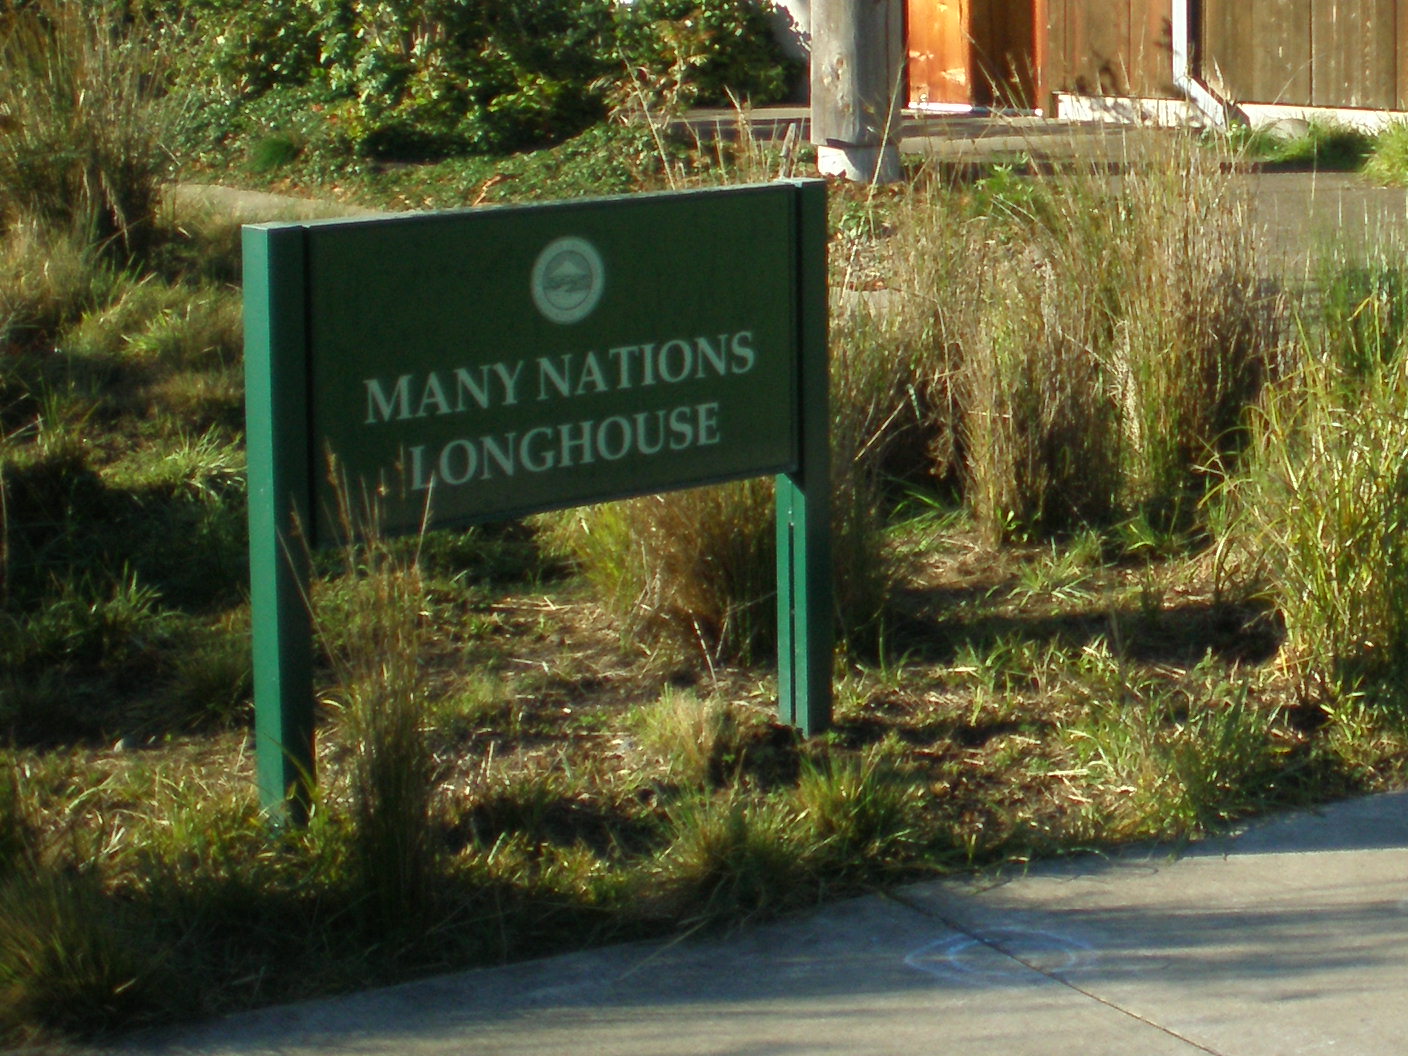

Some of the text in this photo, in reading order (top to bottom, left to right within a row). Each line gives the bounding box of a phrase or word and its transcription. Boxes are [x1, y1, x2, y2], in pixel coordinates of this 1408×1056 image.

[363, 330, 757, 425] MANY NATIONS
[410, 401, 721, 490] LONGHOUSE
